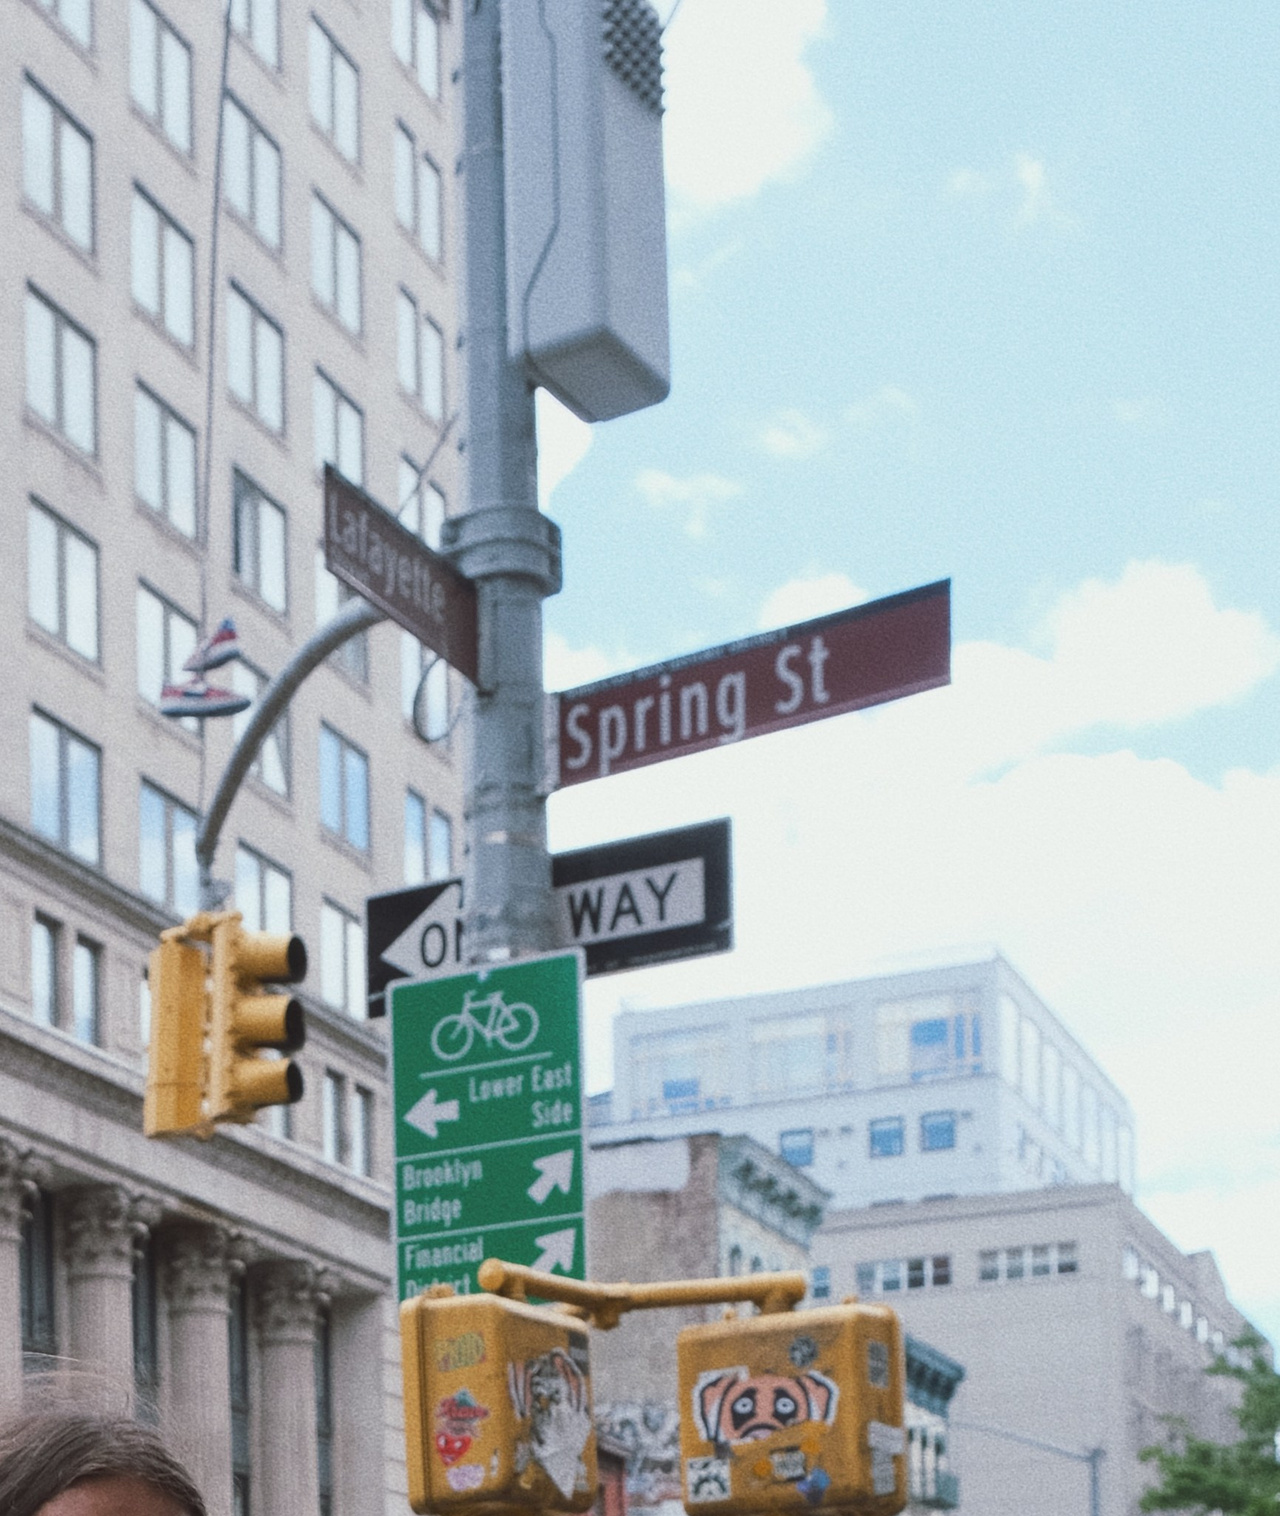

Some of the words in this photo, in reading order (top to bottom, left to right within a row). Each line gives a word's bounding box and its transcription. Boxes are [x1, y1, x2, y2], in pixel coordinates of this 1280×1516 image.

[329, 491, 445, 624] Lafayette
[566, 670, 747, 777] Spring
[774, 636, 831, 715] St
[570, 872, 678, 938] WAY
[469, 1074, 524, 1103] Lower
[531, 1061, 572, 1093] East
[531, 1098, 574, 1128] Side
[402, 1158, 483, 1191] Brooklyn
[403, 1196, 462, 1227] Bridge
[405, 1235, 484, 1270] Financial
